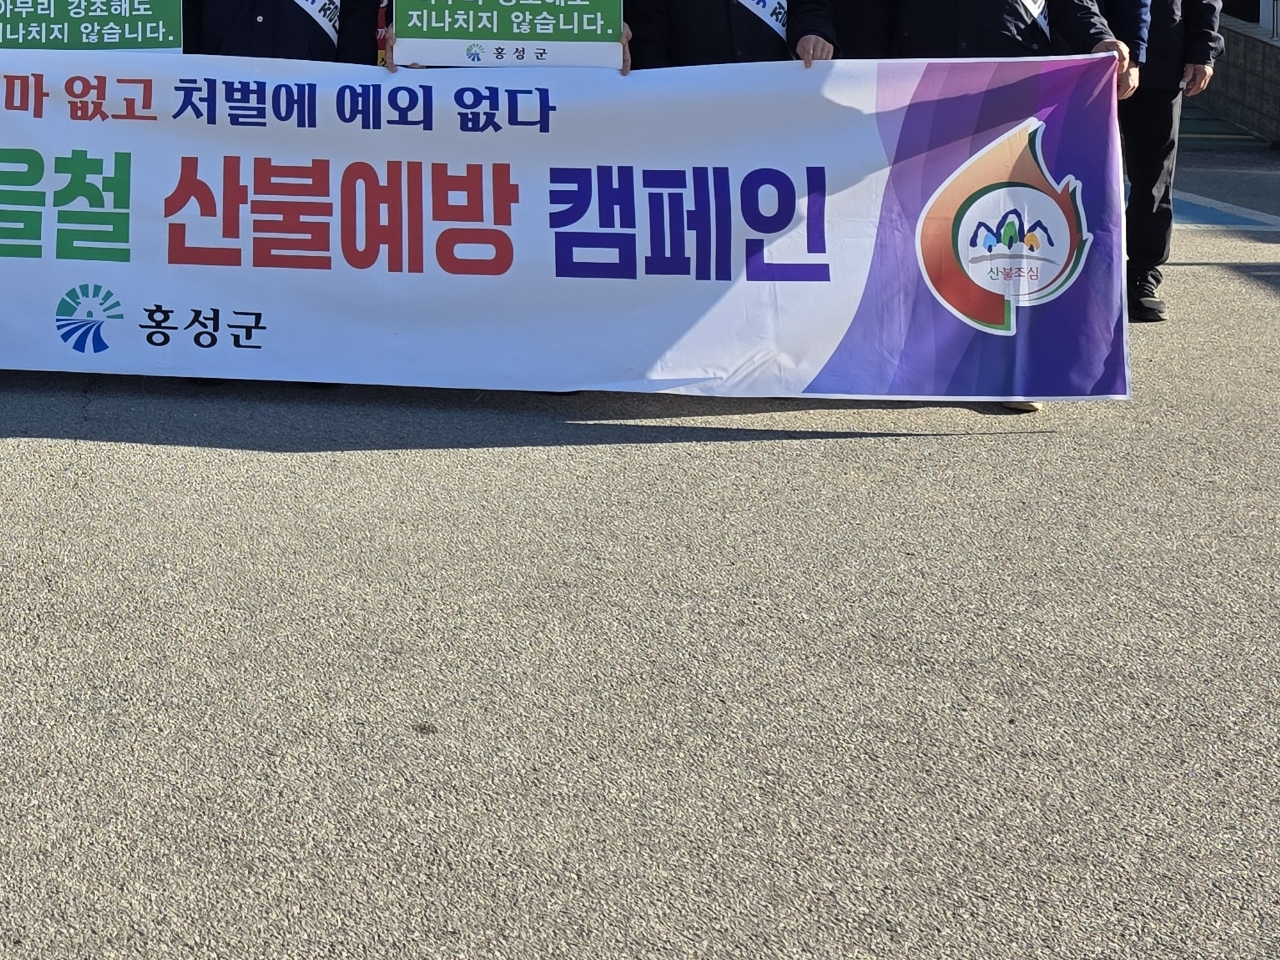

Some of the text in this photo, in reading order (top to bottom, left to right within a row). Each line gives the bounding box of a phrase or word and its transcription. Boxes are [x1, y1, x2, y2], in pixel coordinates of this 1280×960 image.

[79, 20, 174, 43] 않습니다.
[407, 9, 498, 33] 지나치지
[510, 11, 613, 34] 않습니다.
[493, 46, 548, 61] 홍성군
[63, 75, 158, 122] 없고
[171, 77, 318, 129] 처벌에
[335, 83, 434, 131] 예외
[453, 86, 557, 134] 없다
[164, 155, 519, 276] 산불예방
[549, 164, 831, 282] 캠페인
[987, 266, 1040, 281] 산불조심
[138, 304, 268, 350] 홍성군
